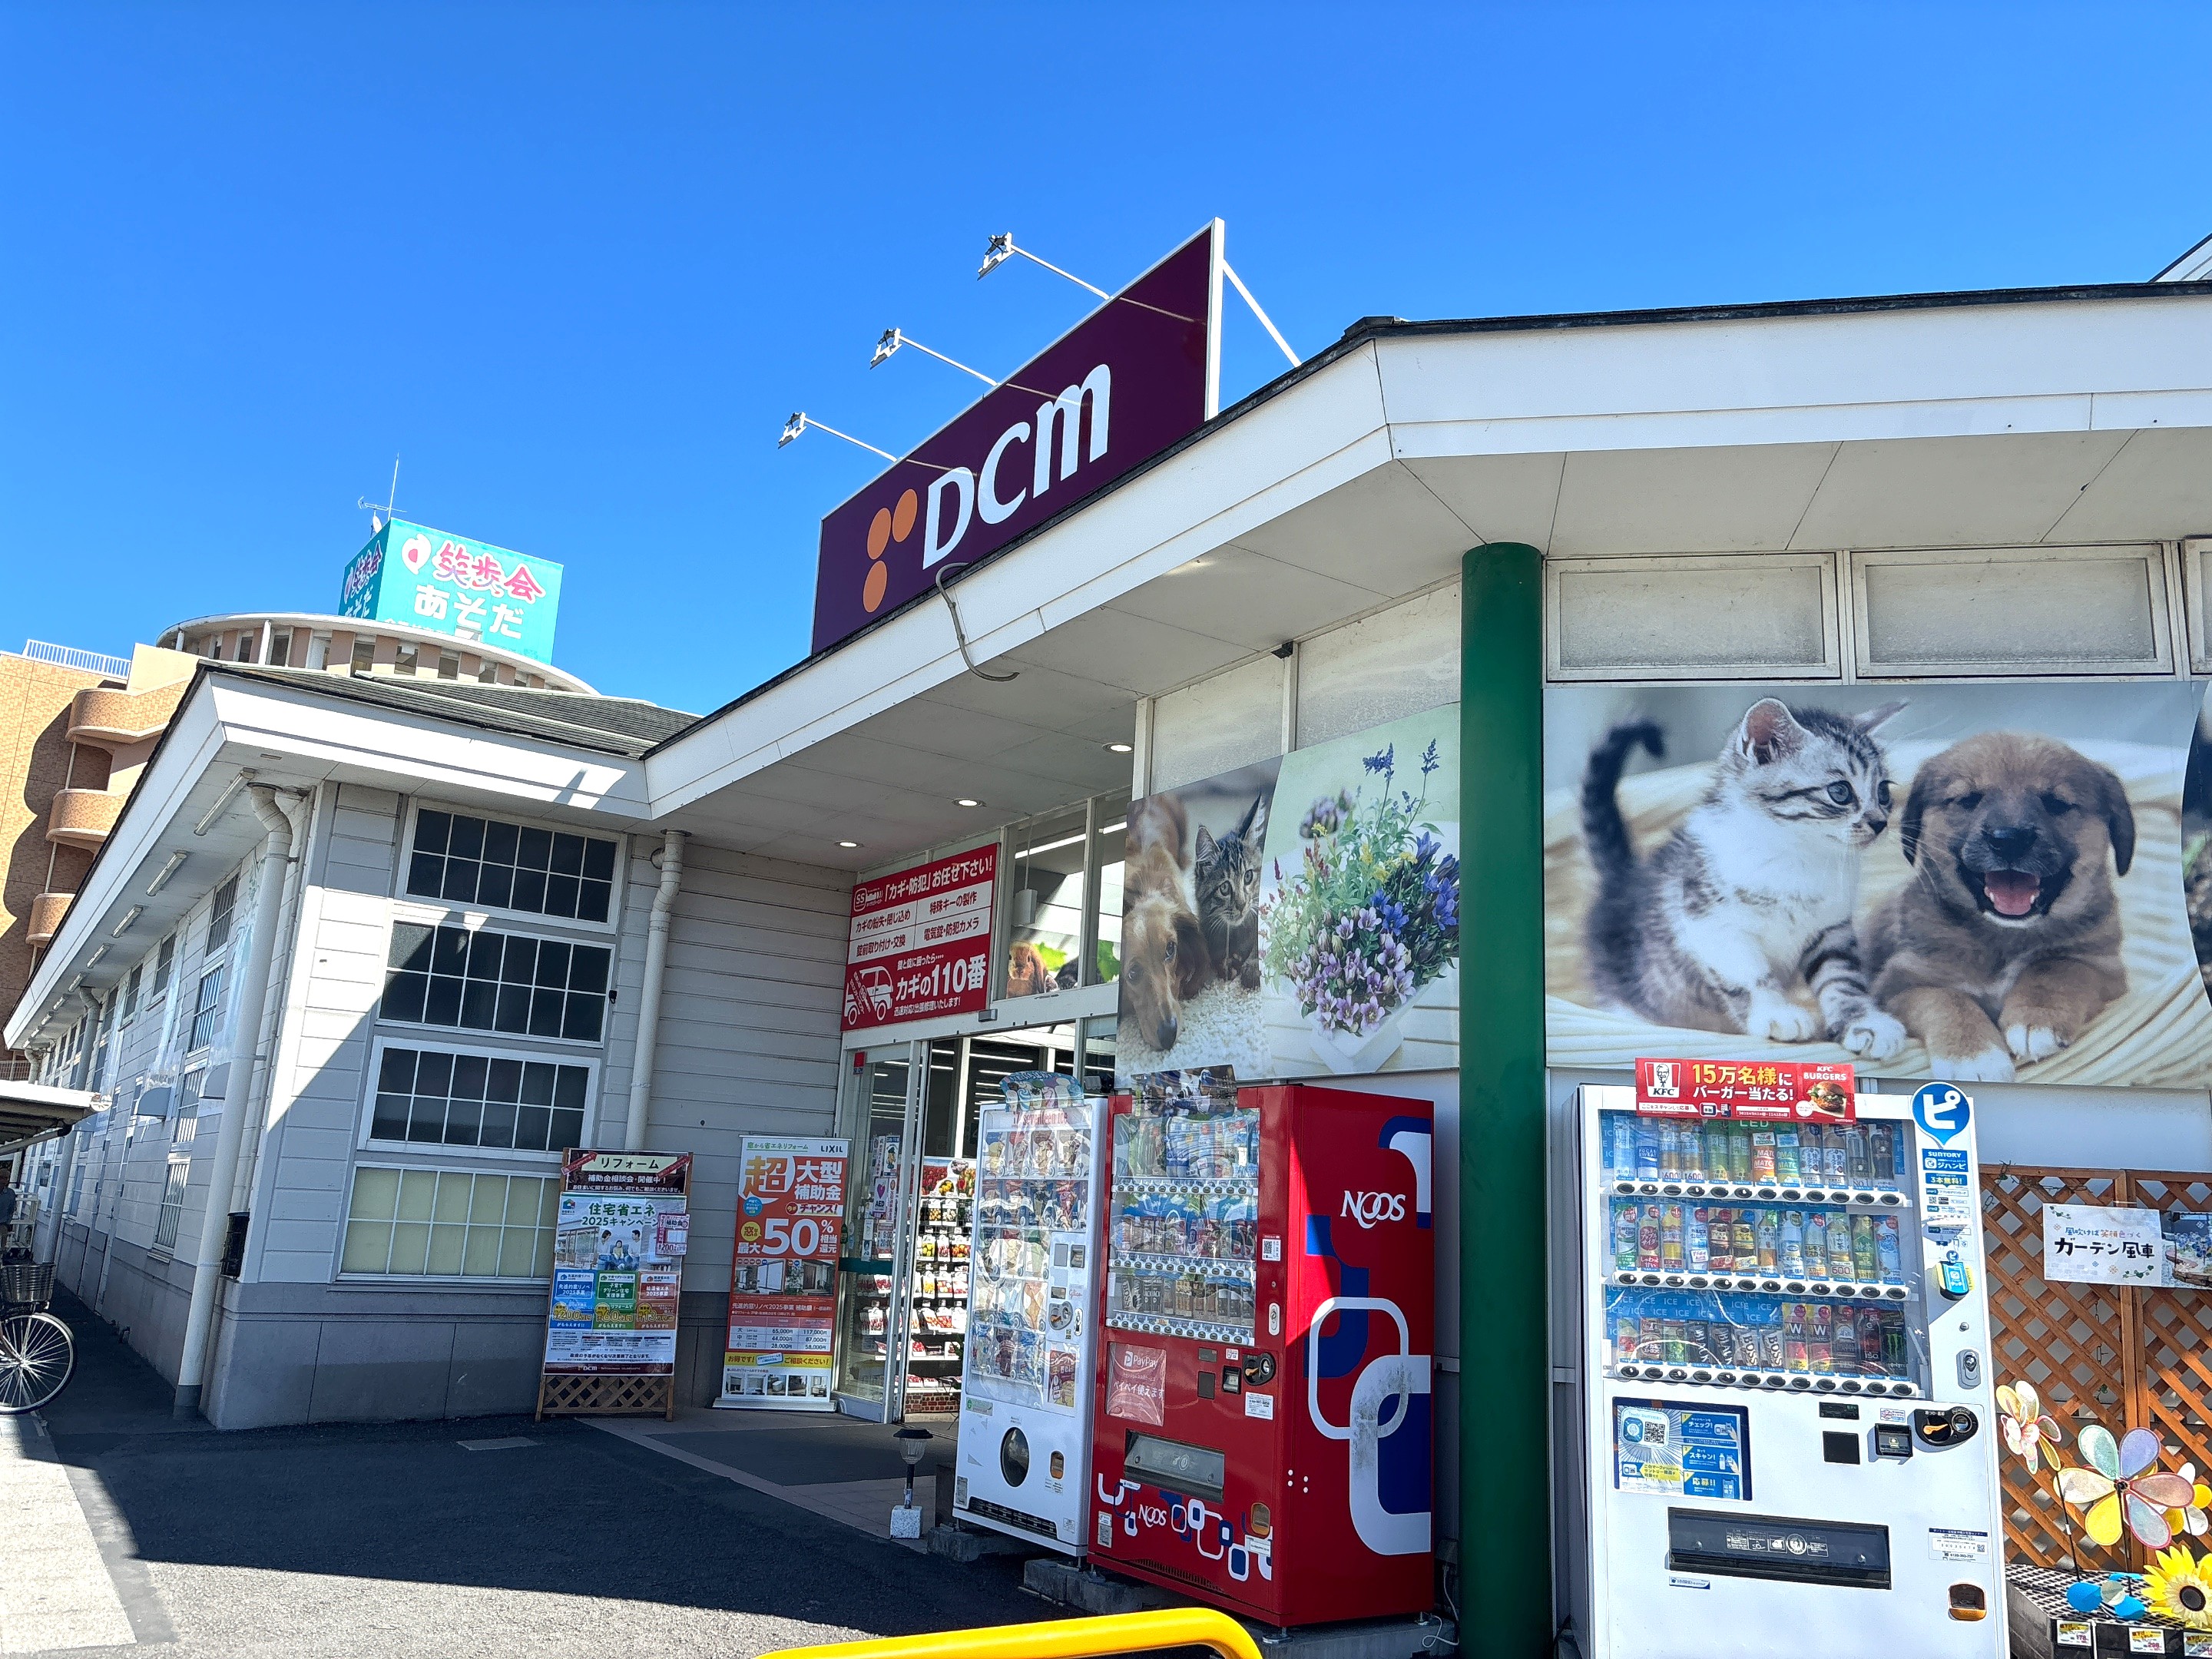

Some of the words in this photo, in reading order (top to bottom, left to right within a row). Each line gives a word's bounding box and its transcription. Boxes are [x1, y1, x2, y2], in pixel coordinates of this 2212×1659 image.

[436, 542, 544, 601] 笑歩会
[415, 584, 525, 639] あそだ
[929, 892, 978, 915] 特殊キーの製作
[924, 917, 979, 940] 電気錠・防犯カメラ
[856, 935, 906, 956] 錠前取り付け・交換
[896, 954, 986, 1002] カギの110番
[1692, 1064, 1793, 1086] 15万名様に
[1803, 1072, 1847, 1081] BURGERS
[1652, 1088, 1675, 1097] KFC
[1693, 1085, 1794, 1101] バーガー当たる!
[1922, 1090, 1961, 1130] ピ
[601, 1157, 659, 1170] リフォーム
[796, 1161, 843, 1184] 大型
[743, 1155, 788, 1197] 超
[795, 1184, 842, 1200] 補助金
[588, 1203, 655, 1217] 住宅省エネ
[800, 1203, 838, 1214] チャンス!
[1340, 1190, 1406, 1229] NOOS
[762, 1218, 820, 1256] 50
[820, 1234, 838, 1243] 相当
[2065, 1227, 2141, 1238] 風吹けば笑顔色づく
[737, 1243, 760, 1254] 最大
[2055, 1238, 2155, 1259] ガーデン風車
[1790, 1323, 1802, 1334] W
[1813, 1325, 1826, 1336] W
[1743, 1335, 1758, 1366] BOSS
[1768, 1335, 1783, 1365] BOSS
[1133, 1355, 1158, 1370] PayPay
[1137, 1504, 1167, 1528] NOOS
